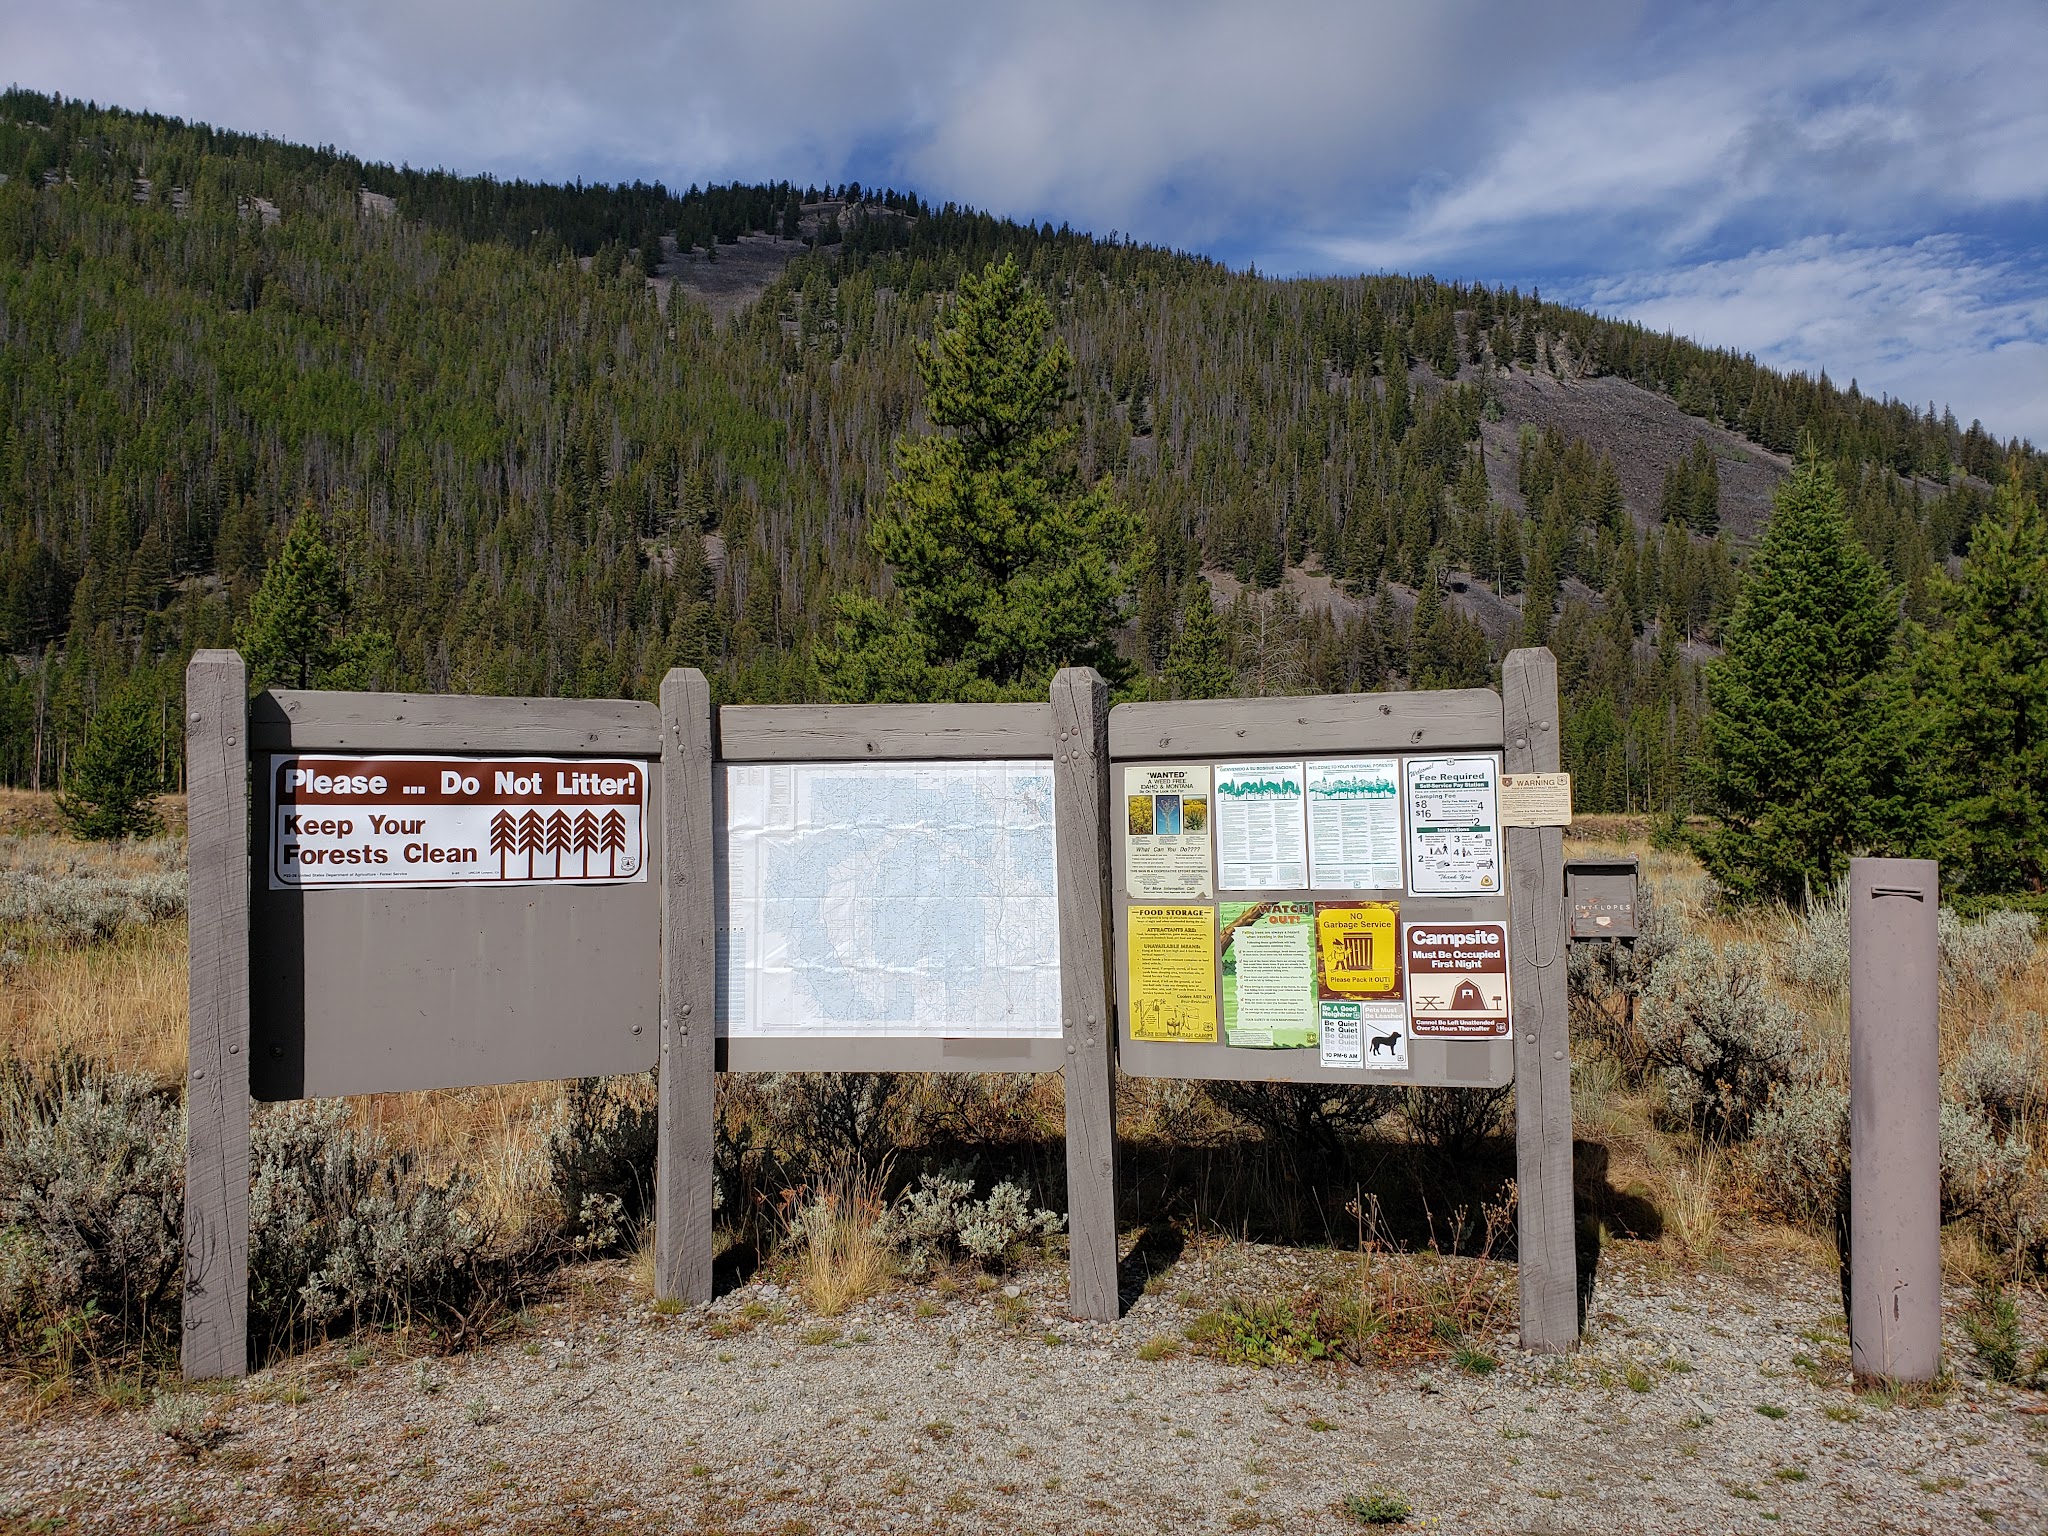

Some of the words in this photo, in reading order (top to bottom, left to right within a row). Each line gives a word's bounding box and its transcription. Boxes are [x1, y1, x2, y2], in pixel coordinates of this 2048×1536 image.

[1409, 763, 1434, 778] Welcome!
[286, 768, 388, 794] Please
[403, 786, 426, 794] ...
[441, 770, 480, 795] Do
[495, 771, 542, 795] Not
[557, 772, 636, 795] Litter!
[1440, 773, 1485, 782] Required
[1416, 800, 1428, 809] $8
[1478, 802, 1484, 810] 4
[1416, 810, 1432, 818] $16
[284, 815, 353, 839] Keep
[369, 815, 426, 835] Your
[1474, 818, 1480, 827] 2
[1418, 835, 1423, 843] 1
[284, 844, 389, 865] Forests
[404, 843, 478, 864] Clean
[1418, 855, 1424, 863] 2
[1259, 905, 1309, 914] WATCH
[1269, 916, 1301, 925] OUT!
[1324, 921, 1359, 930] Garbage
[1412, 930, 1500, 948] Campsite
[1413, 951, 1437, 959] Must
[1438, 951, 1452, 959] Be
[1453, 950, 1501, 960] Occupied
[1432, 960, 1454, 968] First
[1455, 960, 1482, 970] Night
